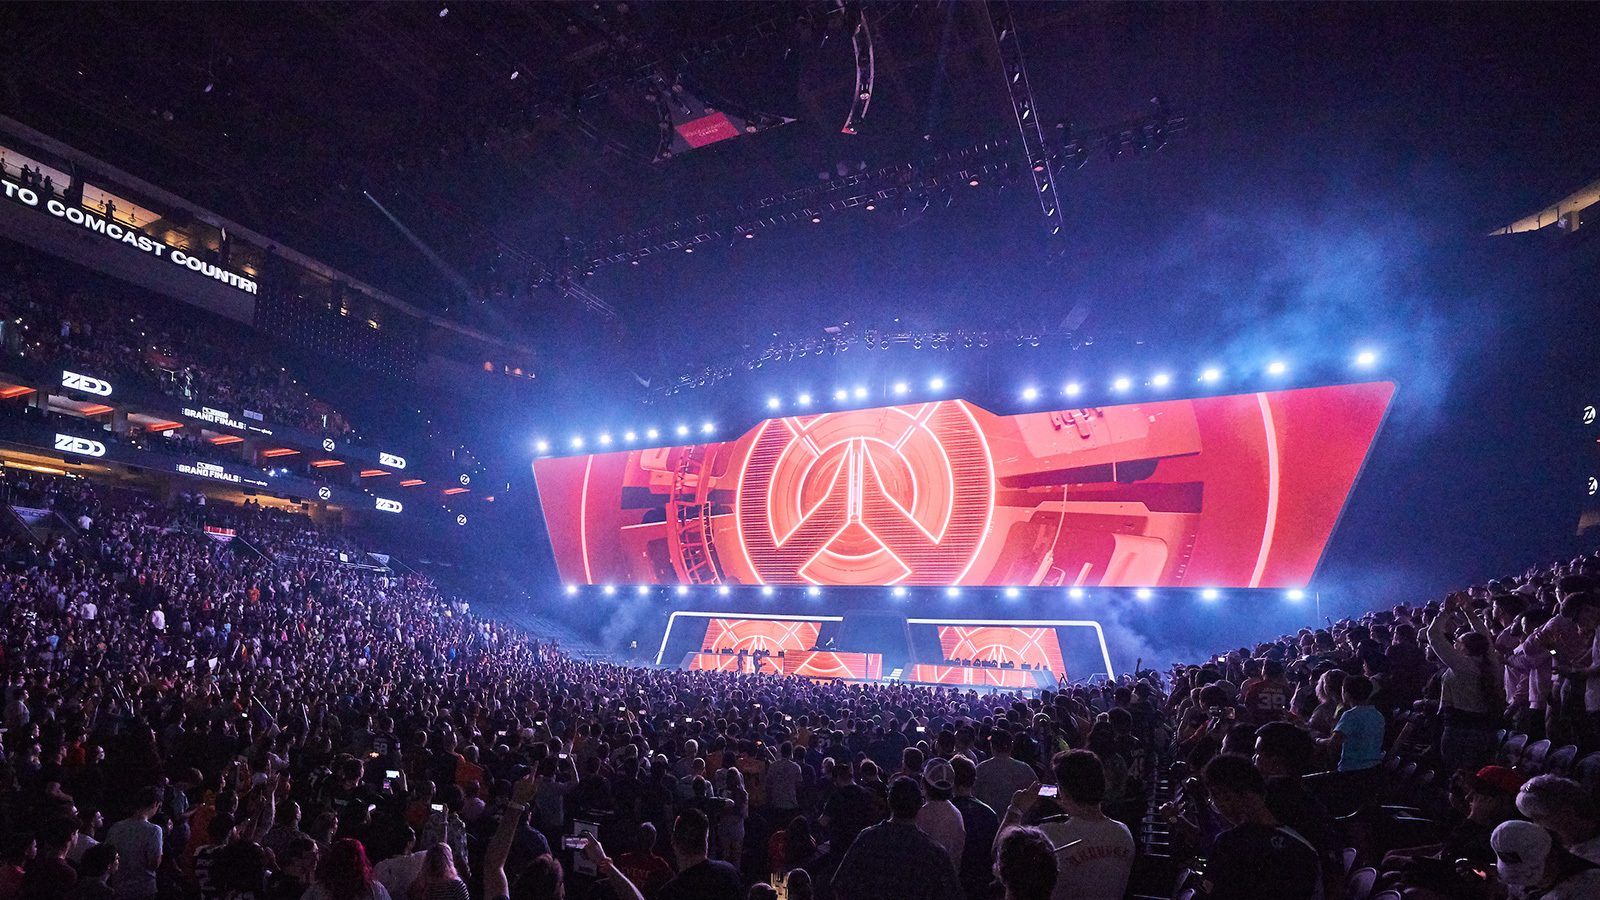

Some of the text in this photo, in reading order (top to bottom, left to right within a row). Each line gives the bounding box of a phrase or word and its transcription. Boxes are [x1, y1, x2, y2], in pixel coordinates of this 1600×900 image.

[1, 179, 39, 206] TO
[47, 199, 166, 256] COMCAST
[62, 370, 112, 396] ZEDD
[184, 408, 214, 422] GRAND
[214, 415, 244, 430] FINALS
[55, 433, 106, 457] ZEDD
[178, 464, 209, 477] GRAND
[209, 470, 239, 482] FINALS
